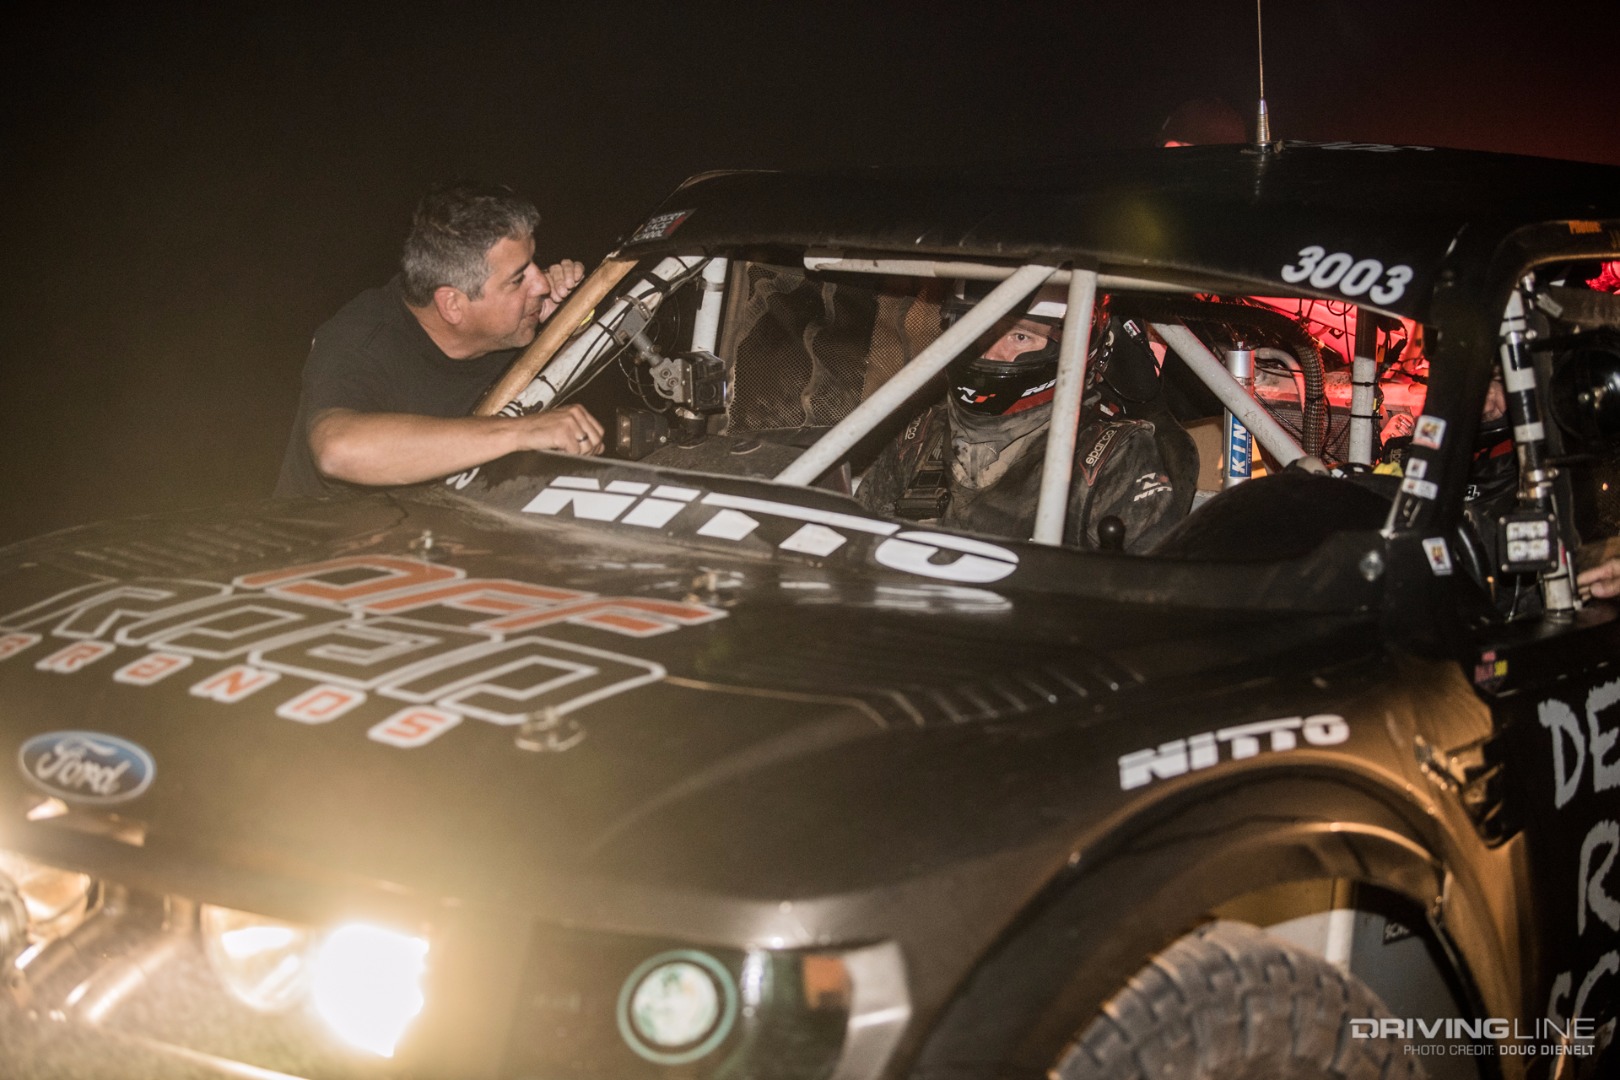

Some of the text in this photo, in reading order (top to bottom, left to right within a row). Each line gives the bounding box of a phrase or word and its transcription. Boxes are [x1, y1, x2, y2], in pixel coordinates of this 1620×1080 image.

[1281, 245, 1414, 305] 3003
[1231, 422, 1247, 475] KIN
[1133, 485, 1173, 502] NITT
[521, 475, 1019, 583] NITTO
[232, 553, 729, 638] OFF
[35, 735, 132, 795] Ford
[1117, 713, 1350, 791] NITTO
